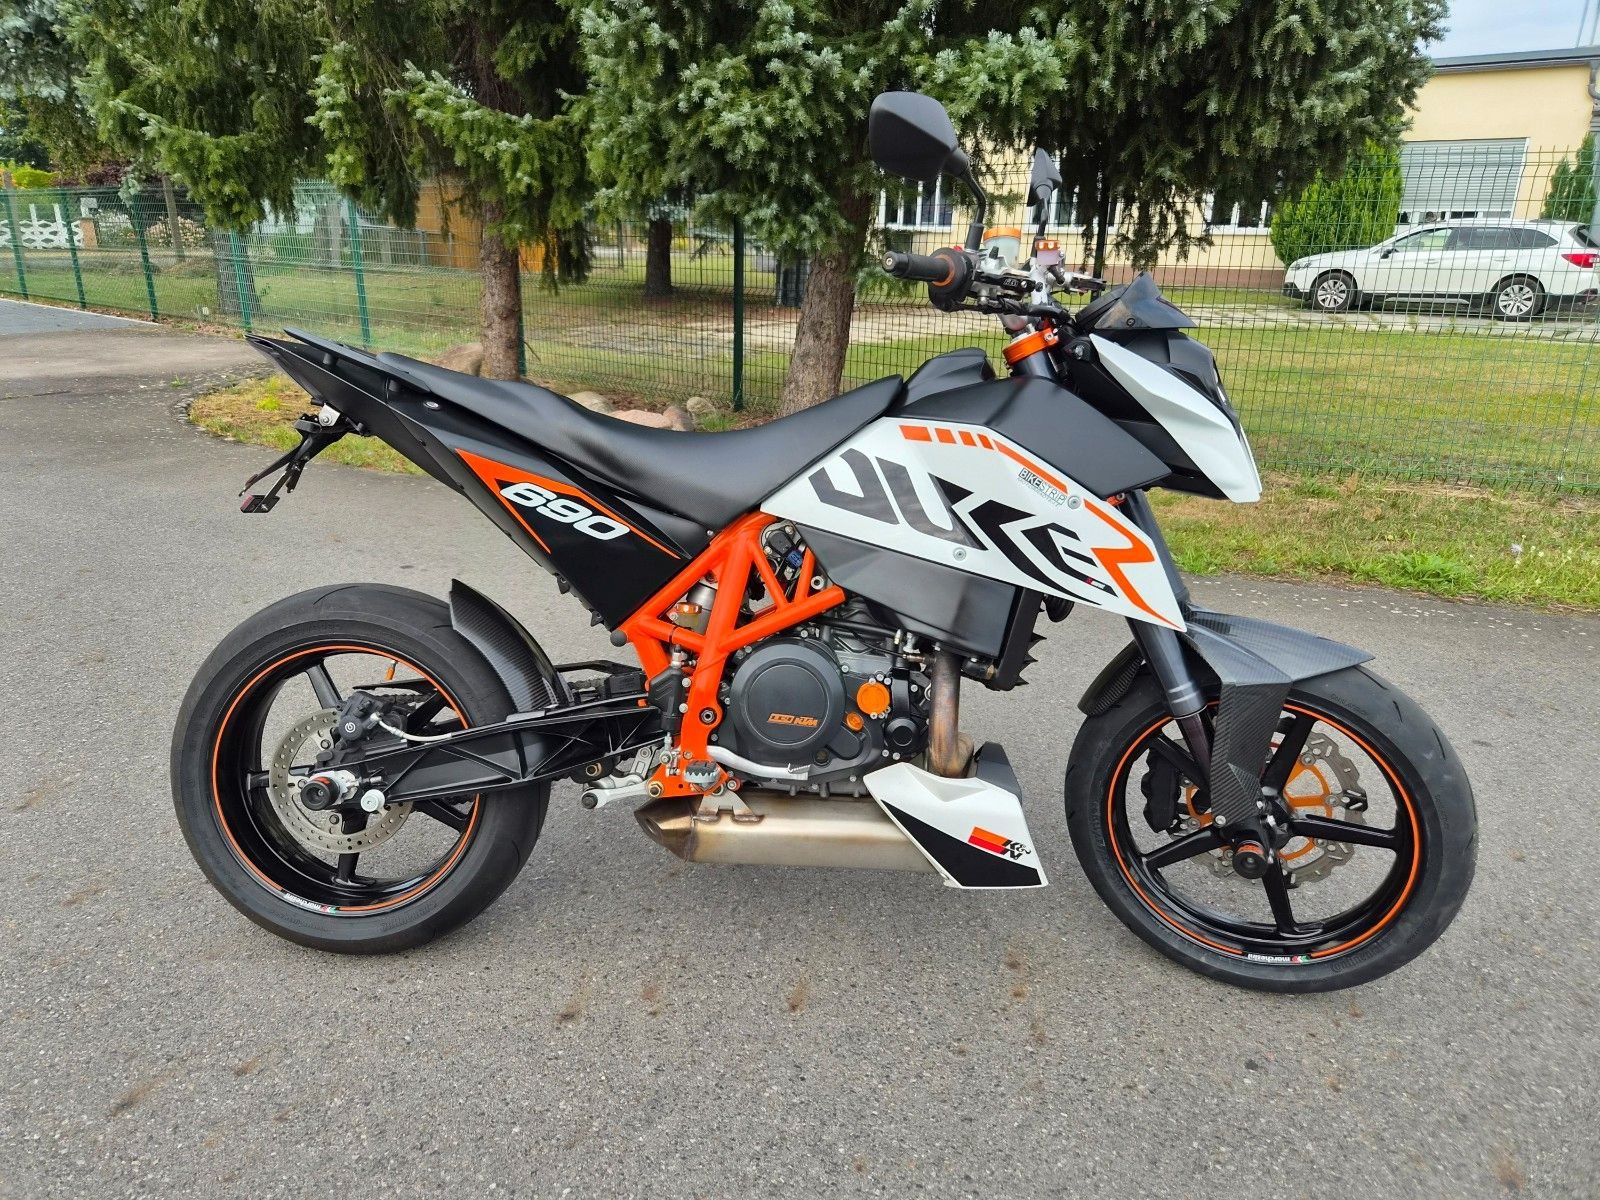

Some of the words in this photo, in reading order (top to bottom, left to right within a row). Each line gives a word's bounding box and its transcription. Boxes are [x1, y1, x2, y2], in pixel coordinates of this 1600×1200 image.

[1018, 467, 1067, 506] BIKESTRIP
[499, 482, 630, 541] 690
[808, 448, 1118, 605] DUKE
[1001, 839, 1032, 860] K&N
